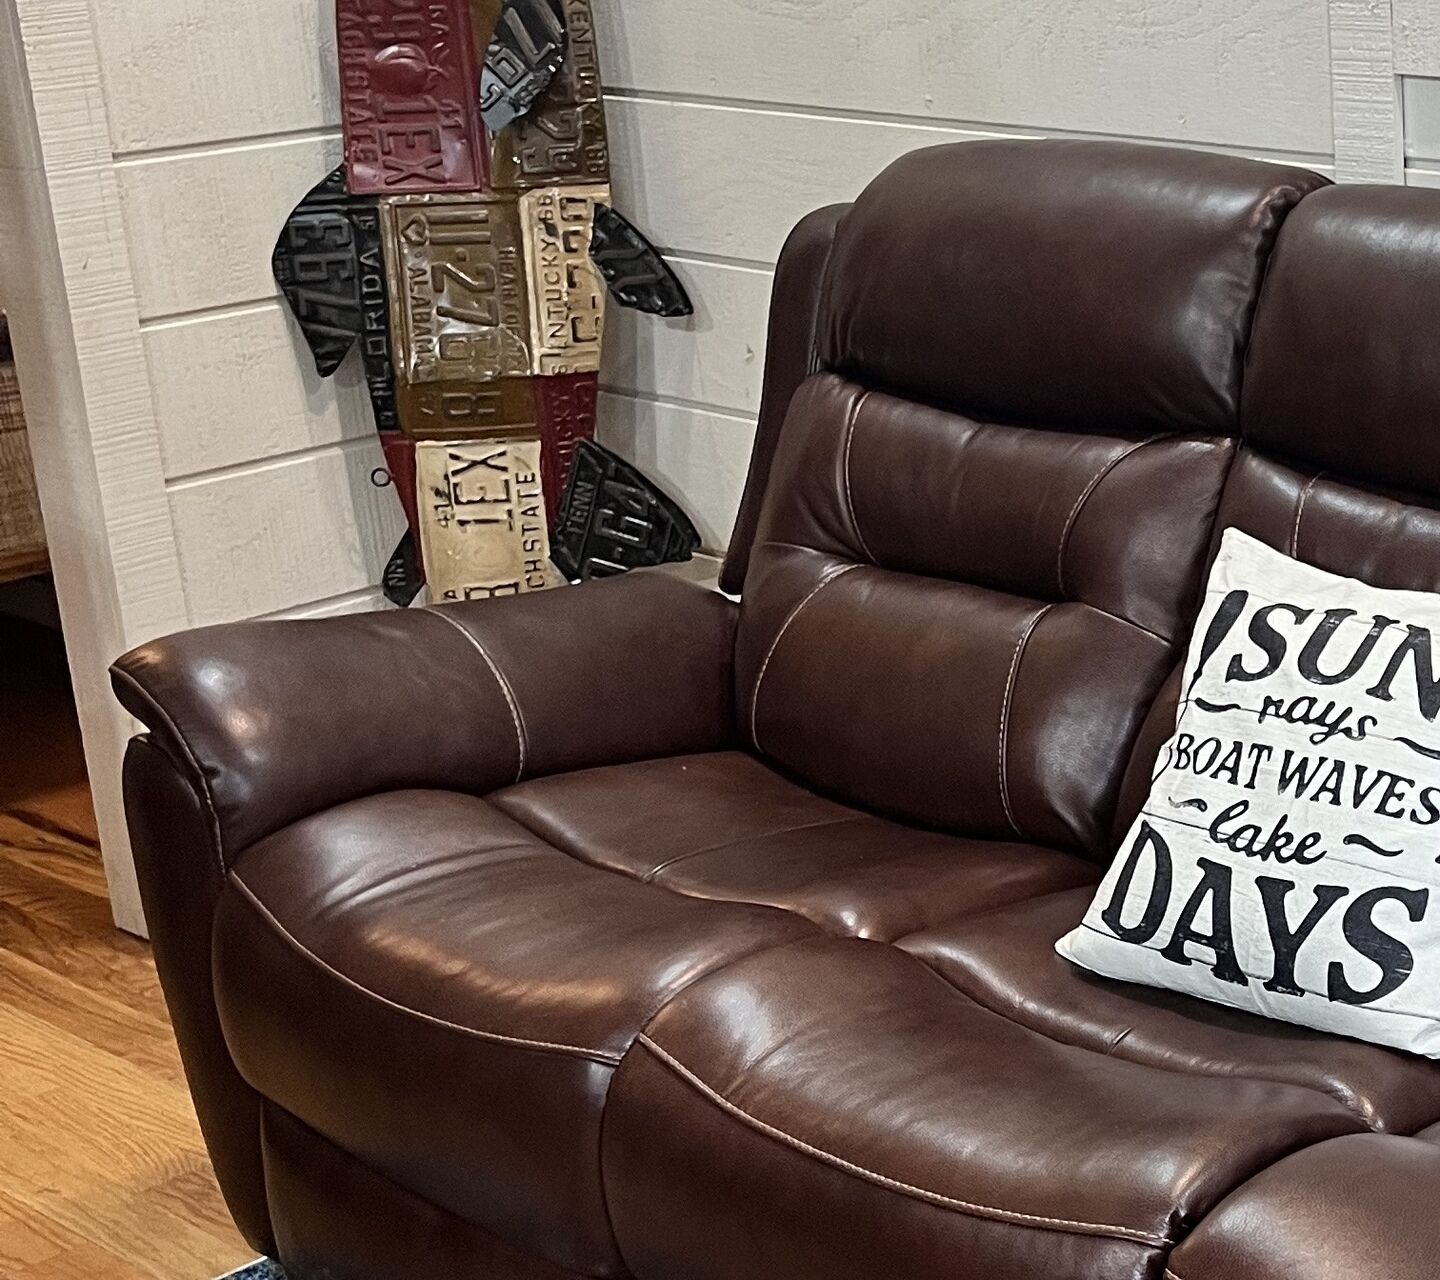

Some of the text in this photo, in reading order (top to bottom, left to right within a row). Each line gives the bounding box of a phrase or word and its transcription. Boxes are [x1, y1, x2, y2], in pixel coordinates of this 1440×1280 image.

[539, 239, 569, 347] NTUCKY
[448, 450, 514, 534] 1EX
[567, 479, 597, 533] TENN
[1257, 694, 1378, 746] rays
[1172, 733, 1275, 792] BOAT
[1207, 800, 1331, 866] lake
[1100, 819, 1430, 1006] DAYS
